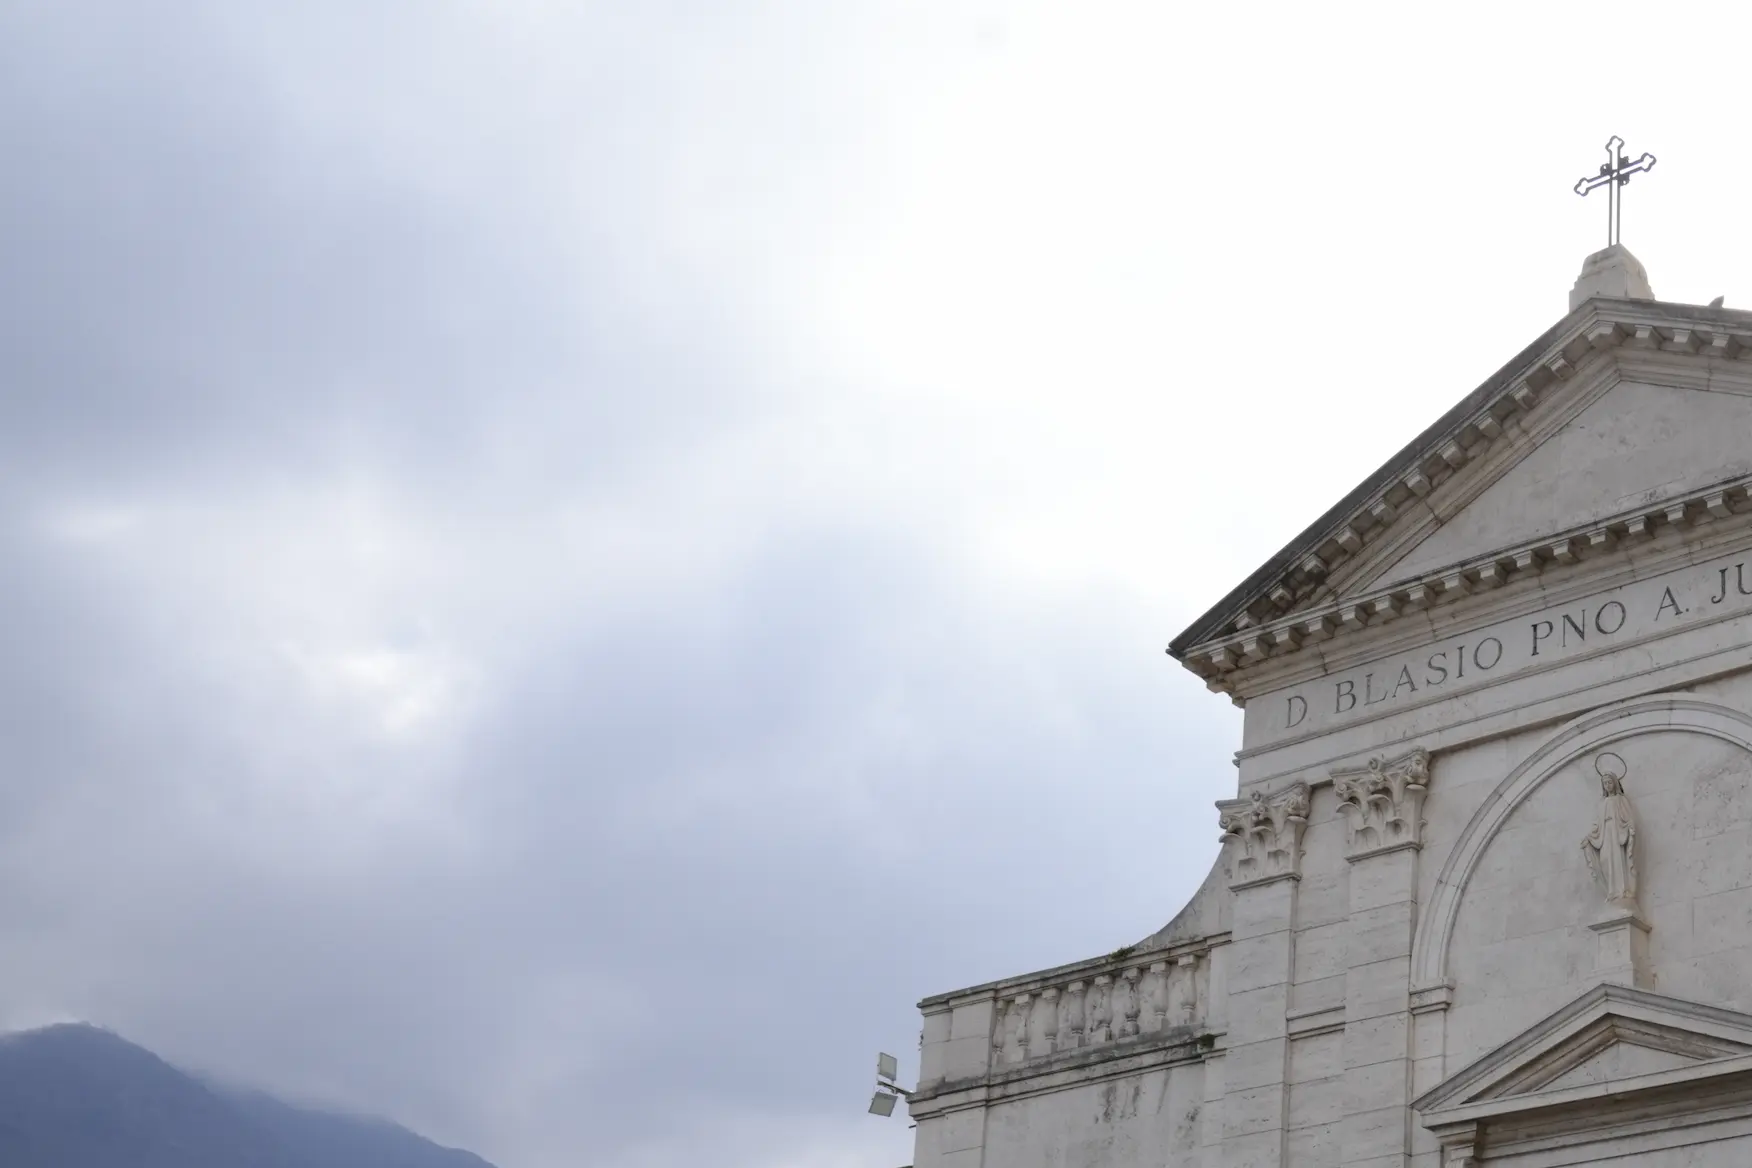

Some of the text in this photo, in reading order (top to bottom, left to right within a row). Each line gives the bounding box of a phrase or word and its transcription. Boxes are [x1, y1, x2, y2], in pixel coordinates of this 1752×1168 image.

[1334, 637, 1503, 714] BLASIO
[1531, 601, 1626, 656] PNO
[1654, 585, 1690, 621] A.
